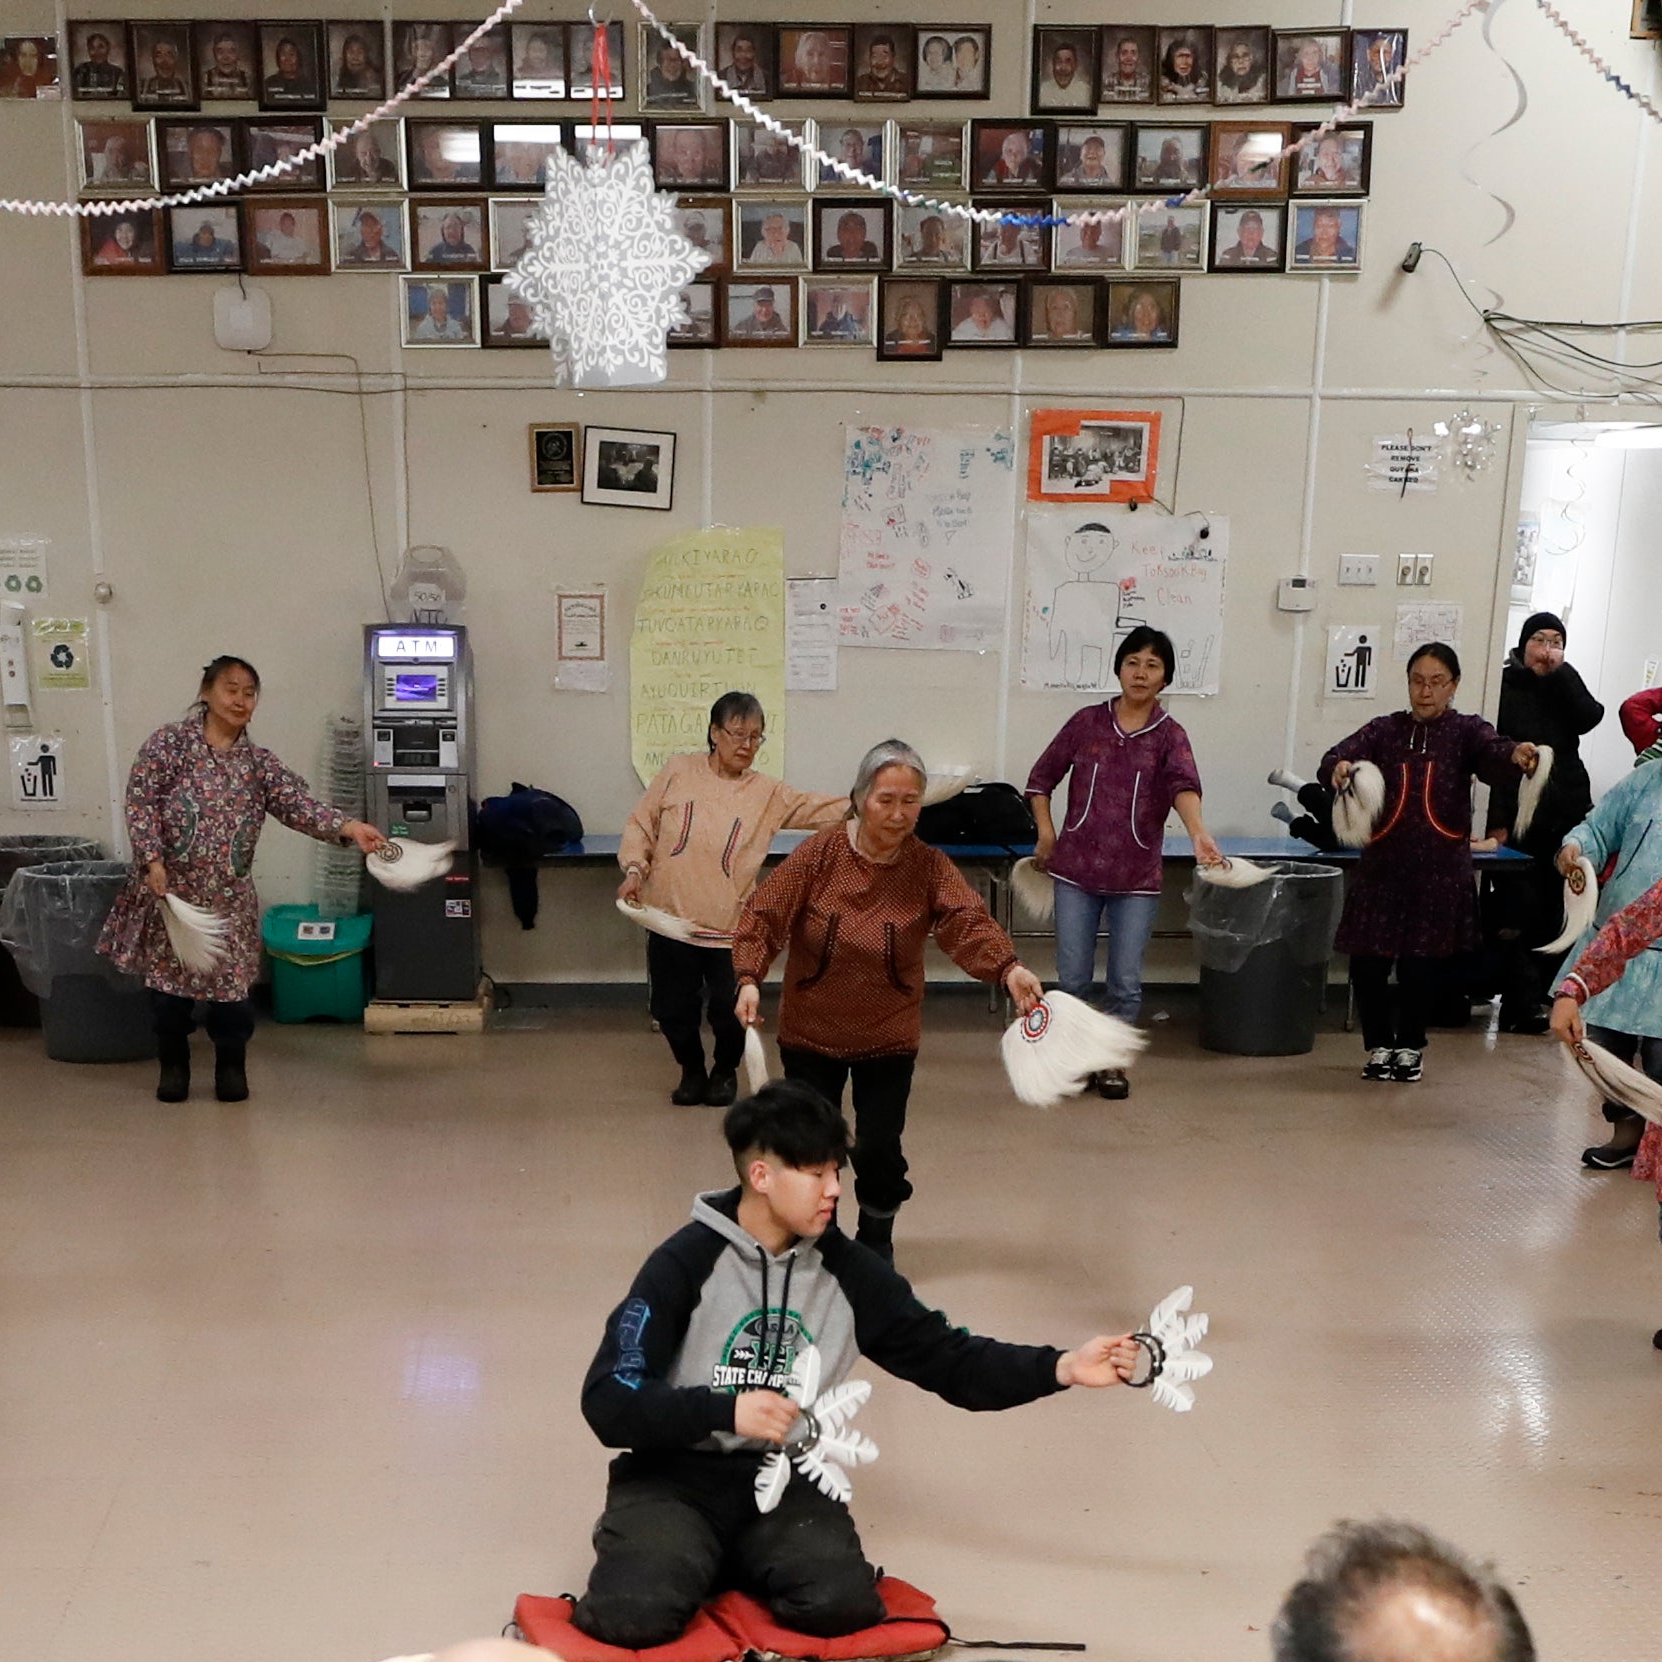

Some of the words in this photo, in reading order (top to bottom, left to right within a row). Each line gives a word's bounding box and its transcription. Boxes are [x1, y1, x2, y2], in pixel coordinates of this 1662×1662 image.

[1131, 542, 1164, 560] Keep
[1157, 587, 1193, 604] Clean
[396, 640, 437, 653] ATM
[712, 1364, 746, 1386] STATE
